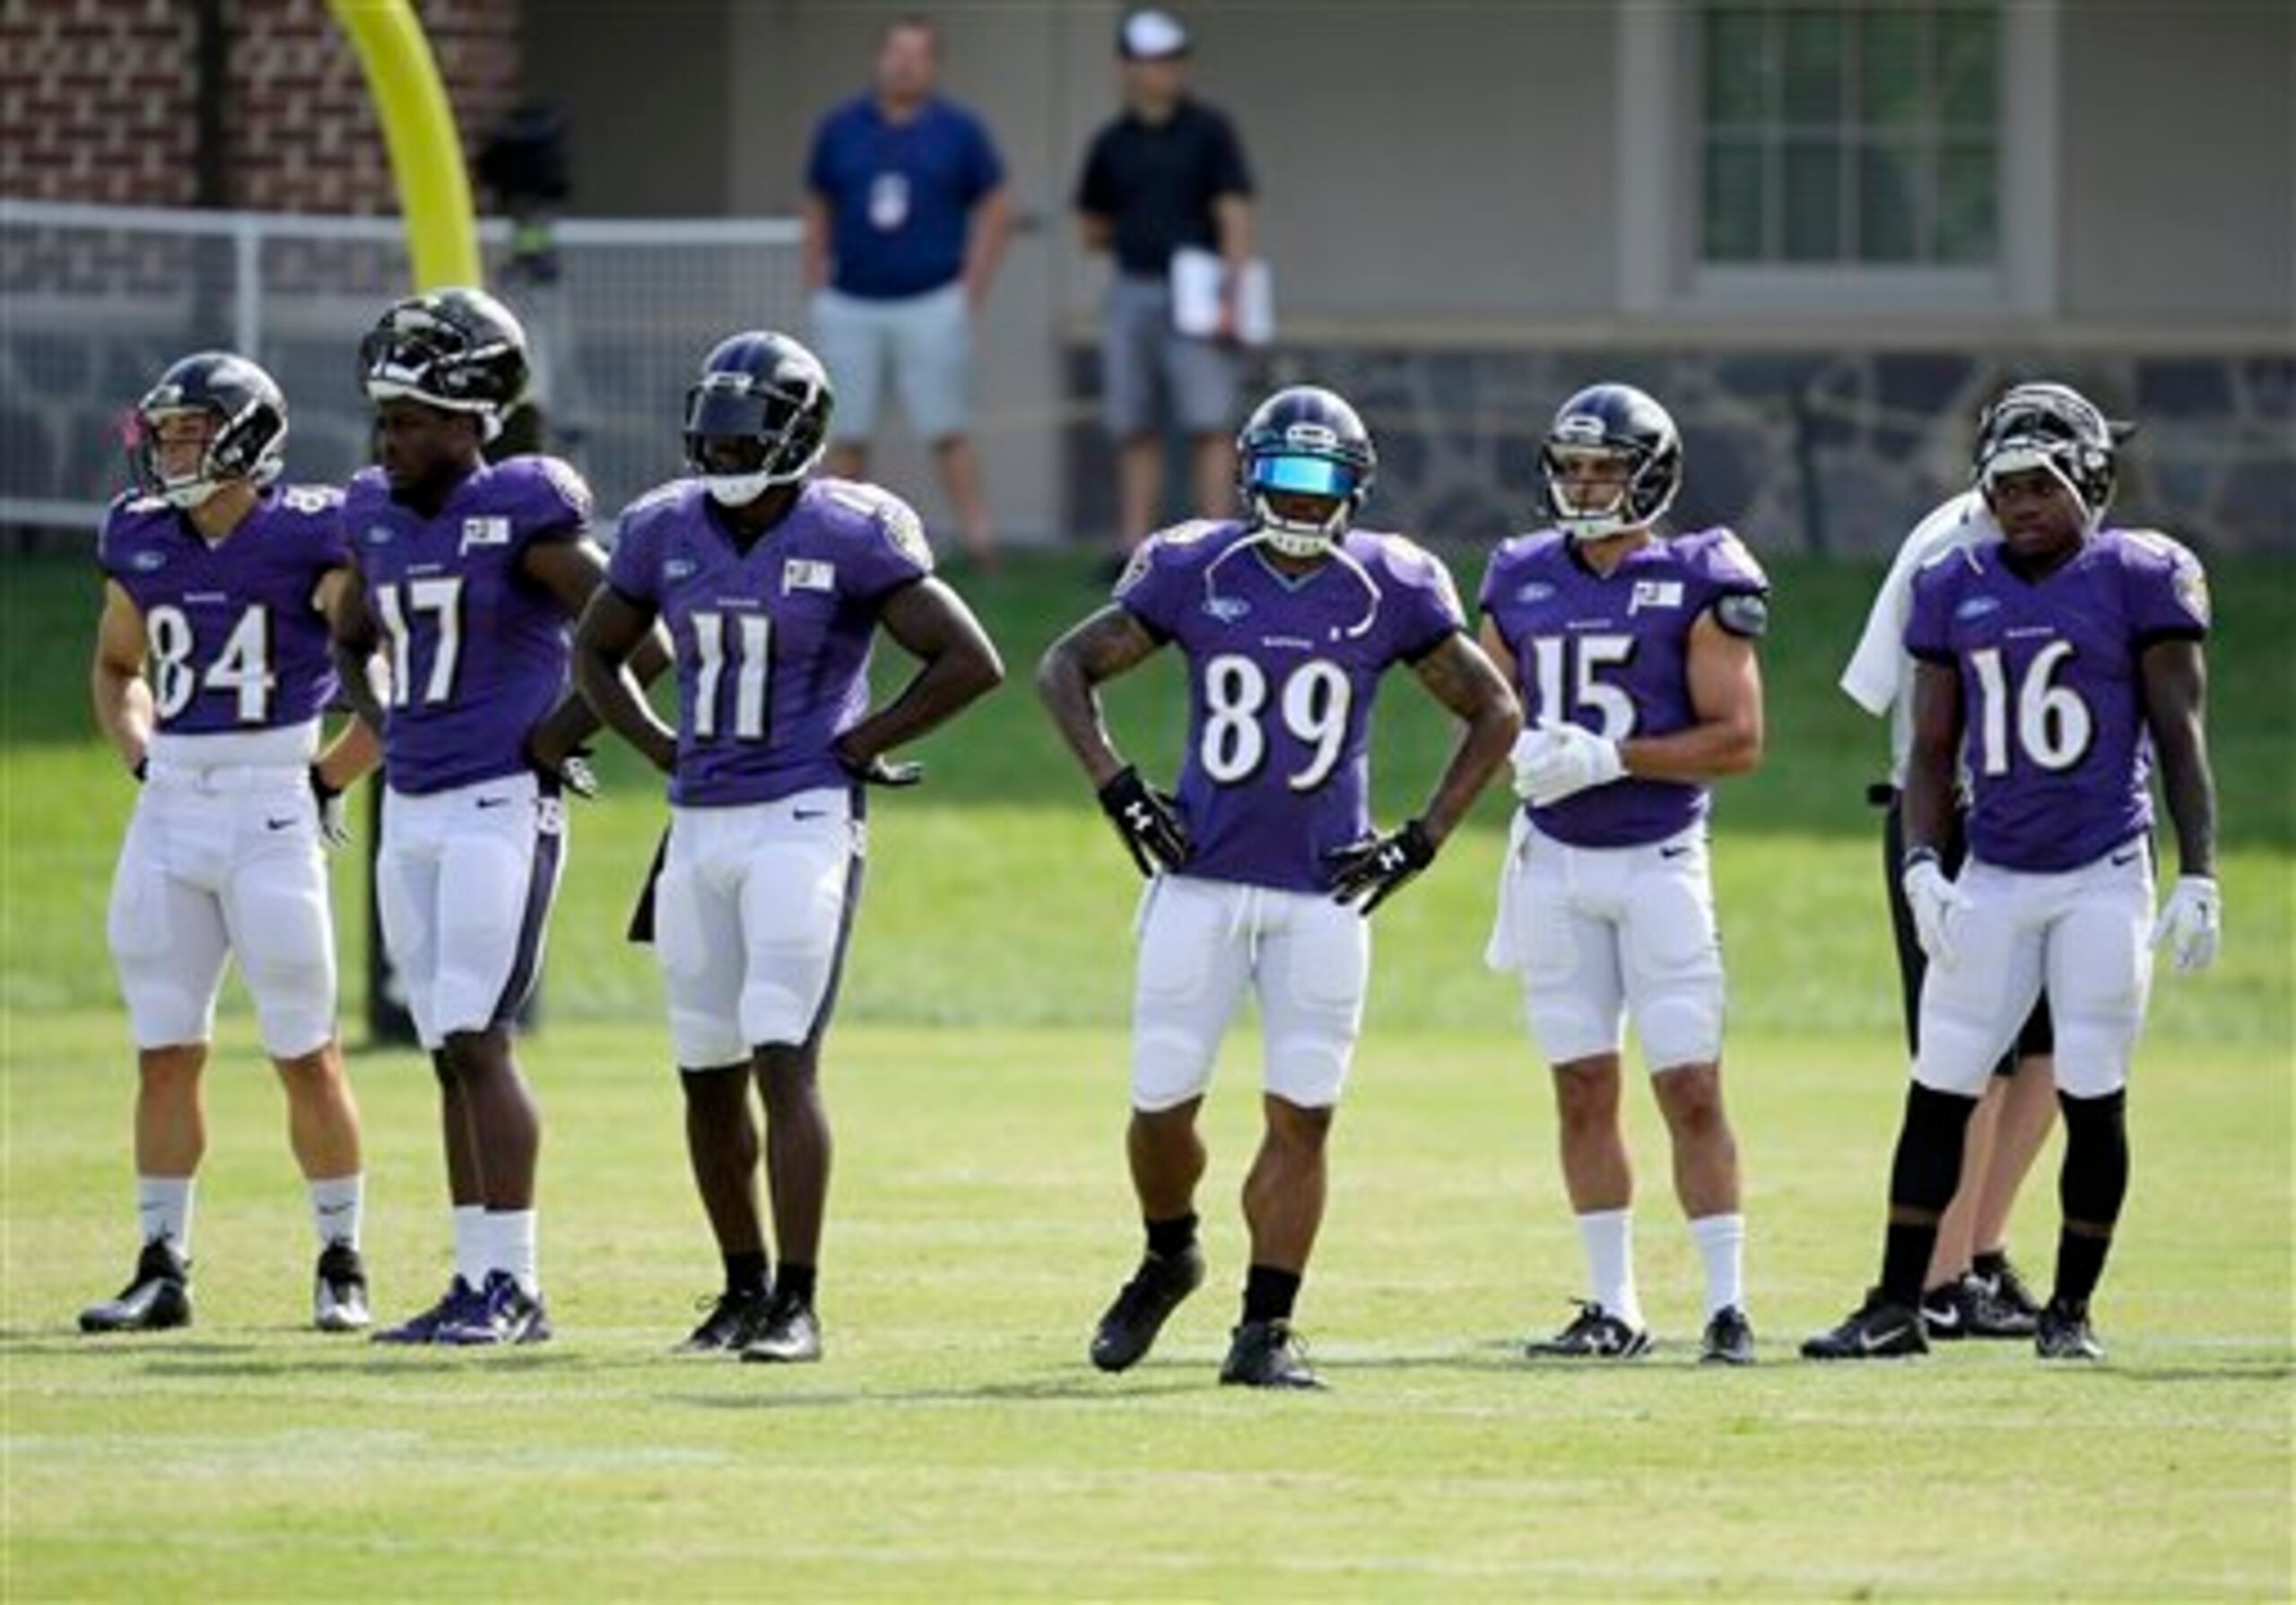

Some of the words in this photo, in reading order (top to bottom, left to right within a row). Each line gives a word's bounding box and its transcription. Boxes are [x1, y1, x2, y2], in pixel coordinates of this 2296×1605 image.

[146, 604, 276, 724] 84
[376, 577, 465, 707] 17
[690, 612, 771, 740] 11
[1532, 635, 1638, 745] 15
[1200, 654, 1352, 792] 89
[1970, 639, 2093, 777] 16
